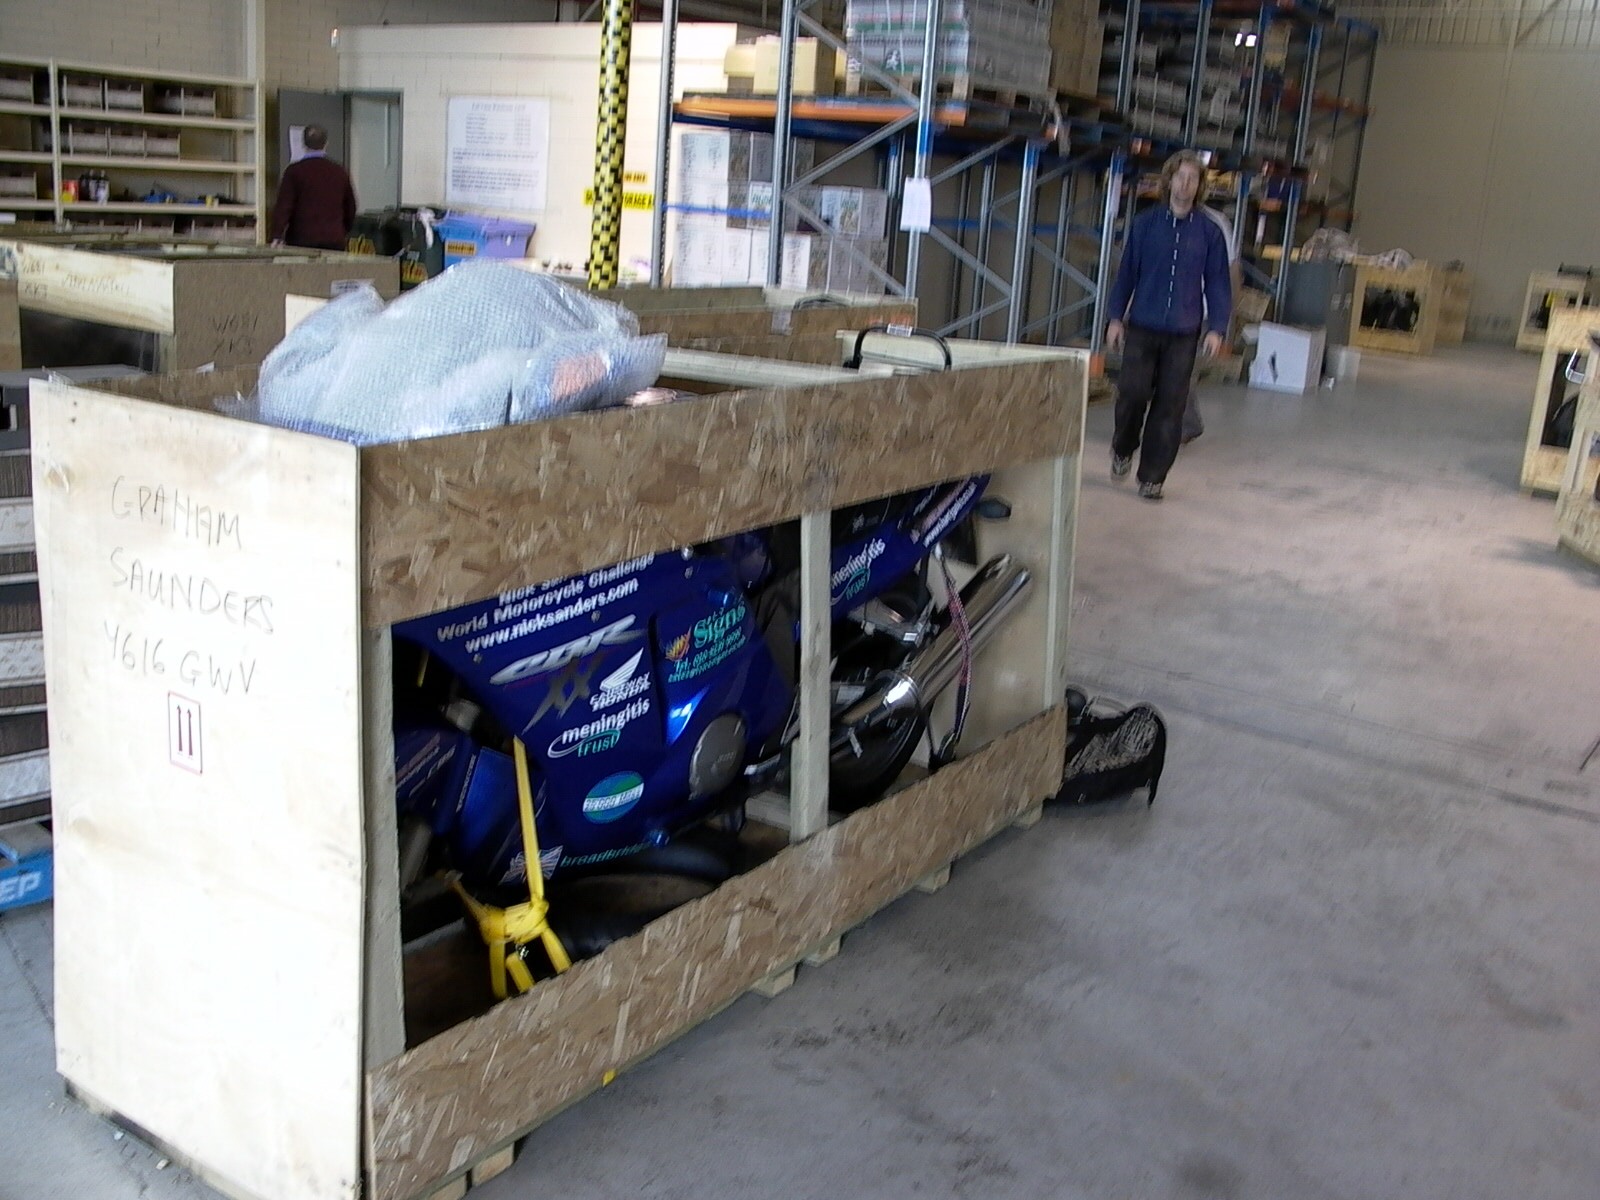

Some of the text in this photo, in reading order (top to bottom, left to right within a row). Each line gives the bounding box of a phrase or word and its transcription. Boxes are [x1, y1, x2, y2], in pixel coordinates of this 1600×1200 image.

[110, 475, 242, 549] GRAHAM
[109, 546, 274, 634] SAUNDERS
[436, 612, 489, 642] World
[493, 578, 585, 624] Motorcycle
[588, 552, 655, 588] Challenge
[464, 577, 639, 654] www.nicksanders.com
[694, 606, 746, 649] Signs
[103, 620, 257, 695] 4616 GWV
[562, 696, 650, 745] meningitis
